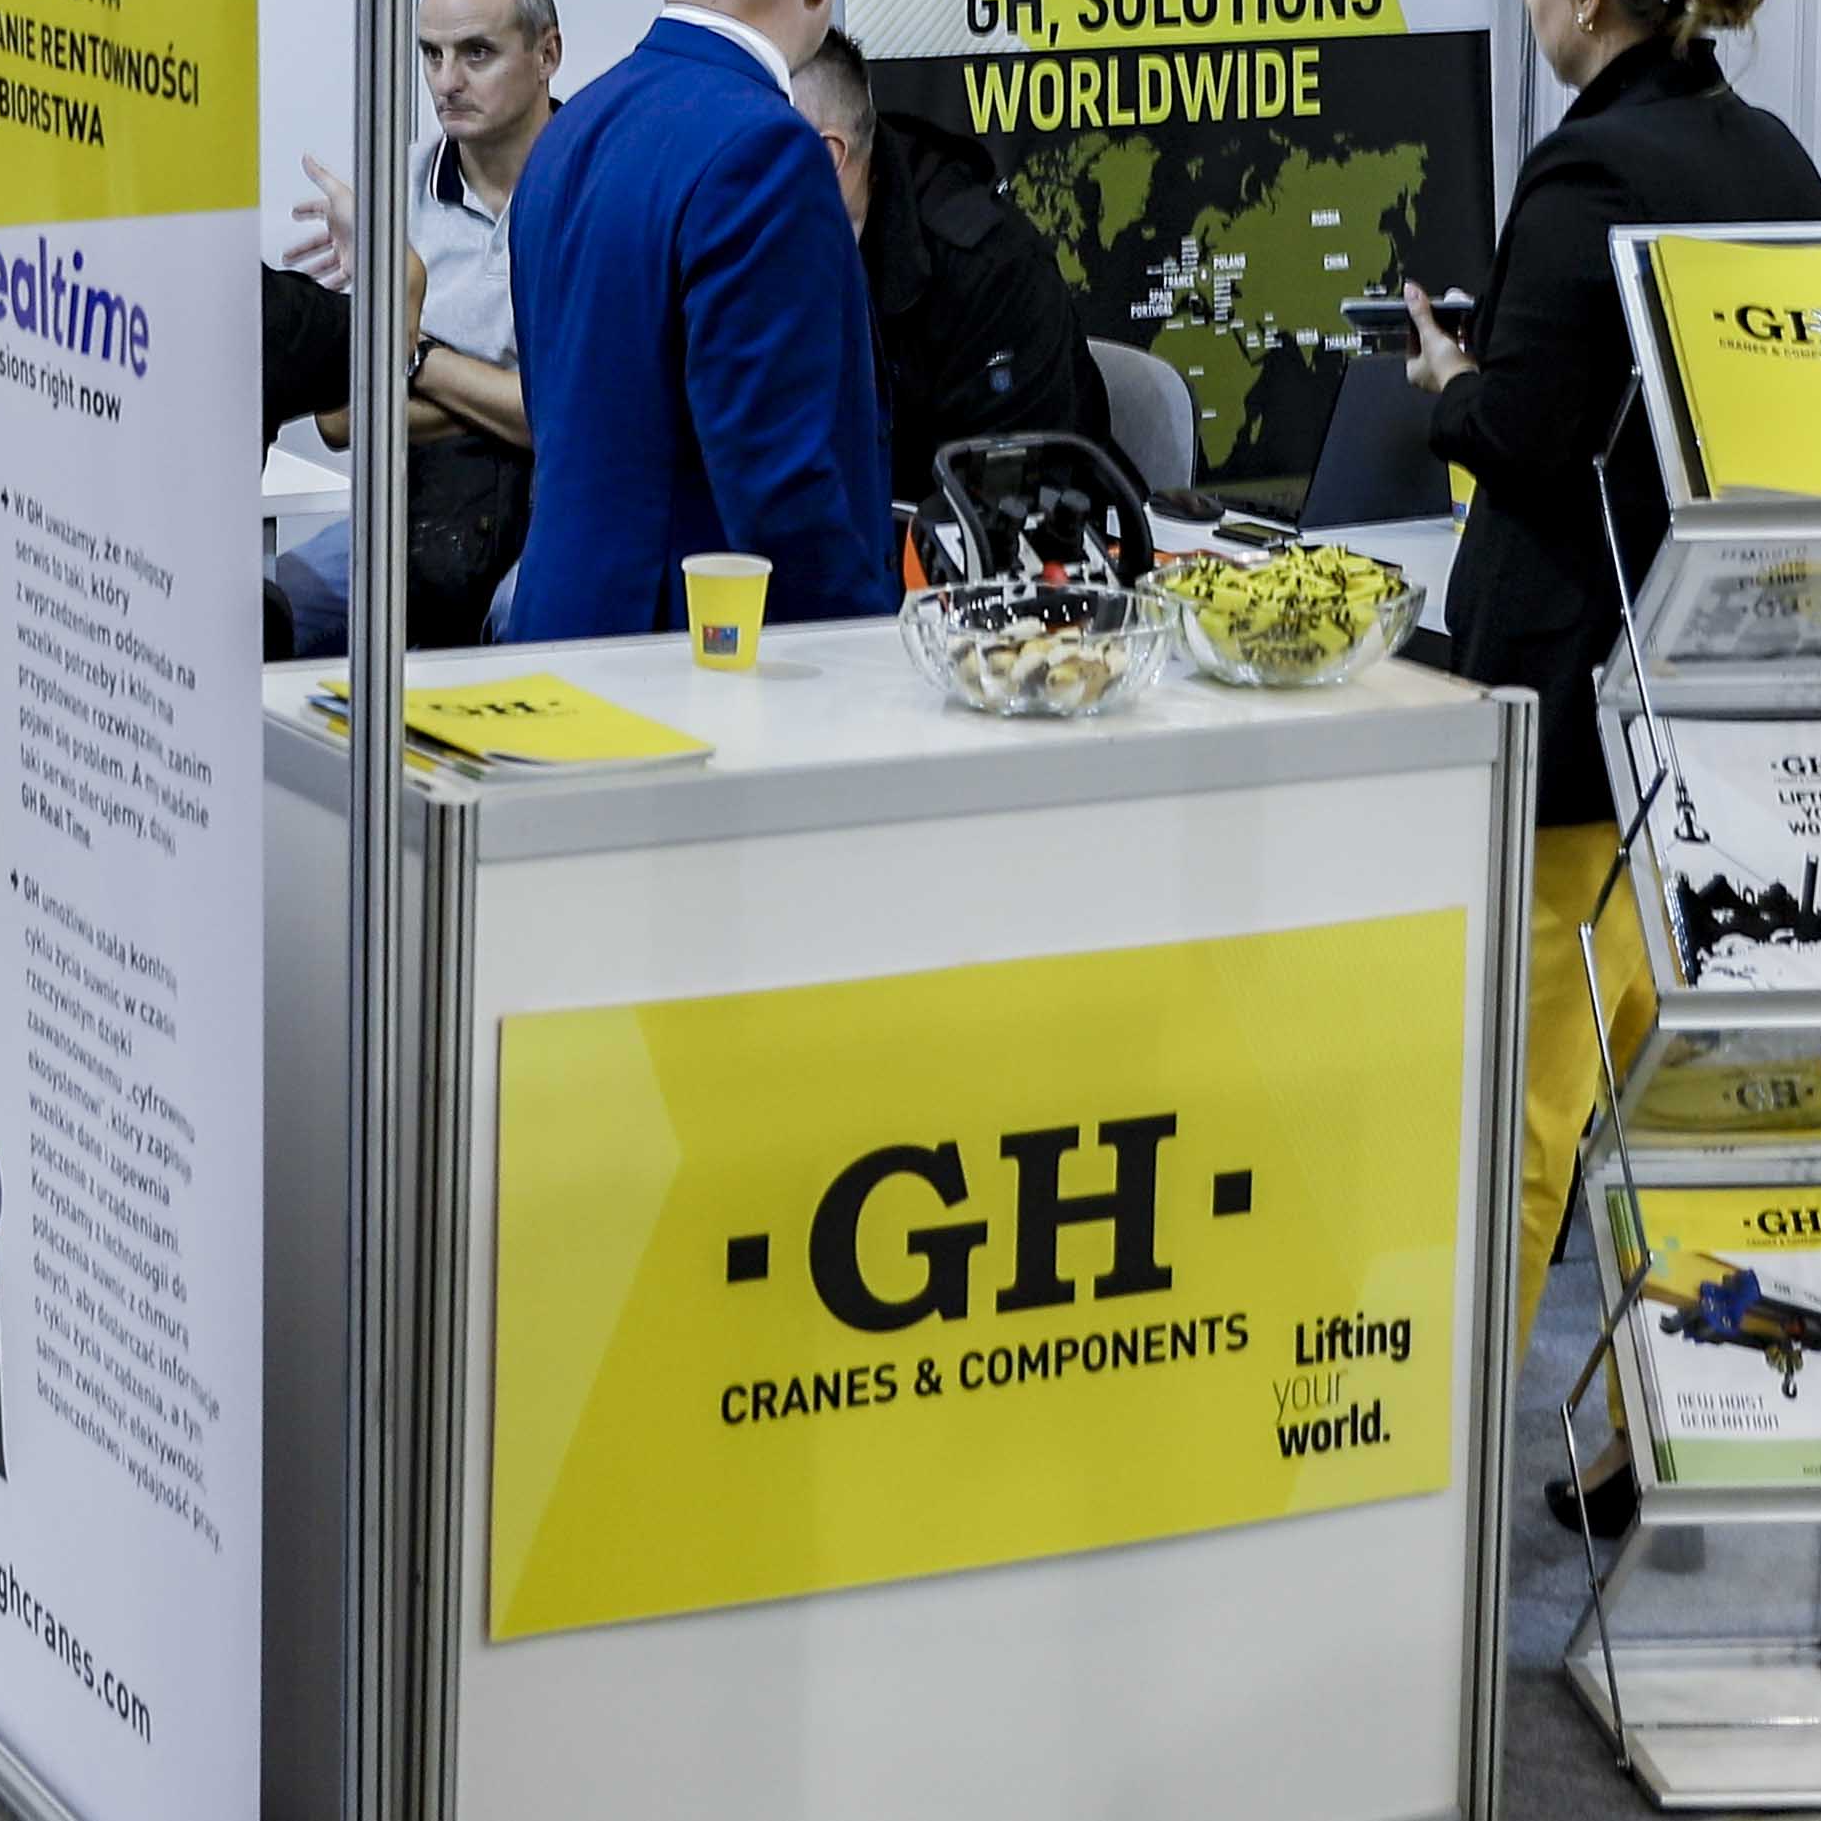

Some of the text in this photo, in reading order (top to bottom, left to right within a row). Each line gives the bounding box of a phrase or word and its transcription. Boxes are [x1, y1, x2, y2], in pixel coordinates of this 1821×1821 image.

[42, 27, 199, 107] RENTOWNOŚCI
[964, 46, 1321, 134] WORLDWIDE
[1213, 252, 1246, 270] POLAND
[1131, 301, 1173, 320] PORTUGAL
[40, 368, 75, 411] right
[80, 385, 121, 423] now
[91, 574, 130, 616] który
[64, 650, 117, 698] potrzeby
[168, 749, 212, 785] zanim
[39, 793, 62, 828] Real
[110, 1154, 170, 1206] zapewnia
[808, 1111, 1177, 1334] GH
[1294, 1314, 1411, 1369] Lifting
[720, 1312, 1249, 1426] CRANES & COMPONENTS
[1272, 1370, 1347, 1423] your
[1278, 1399, 1391, 1458] world.
